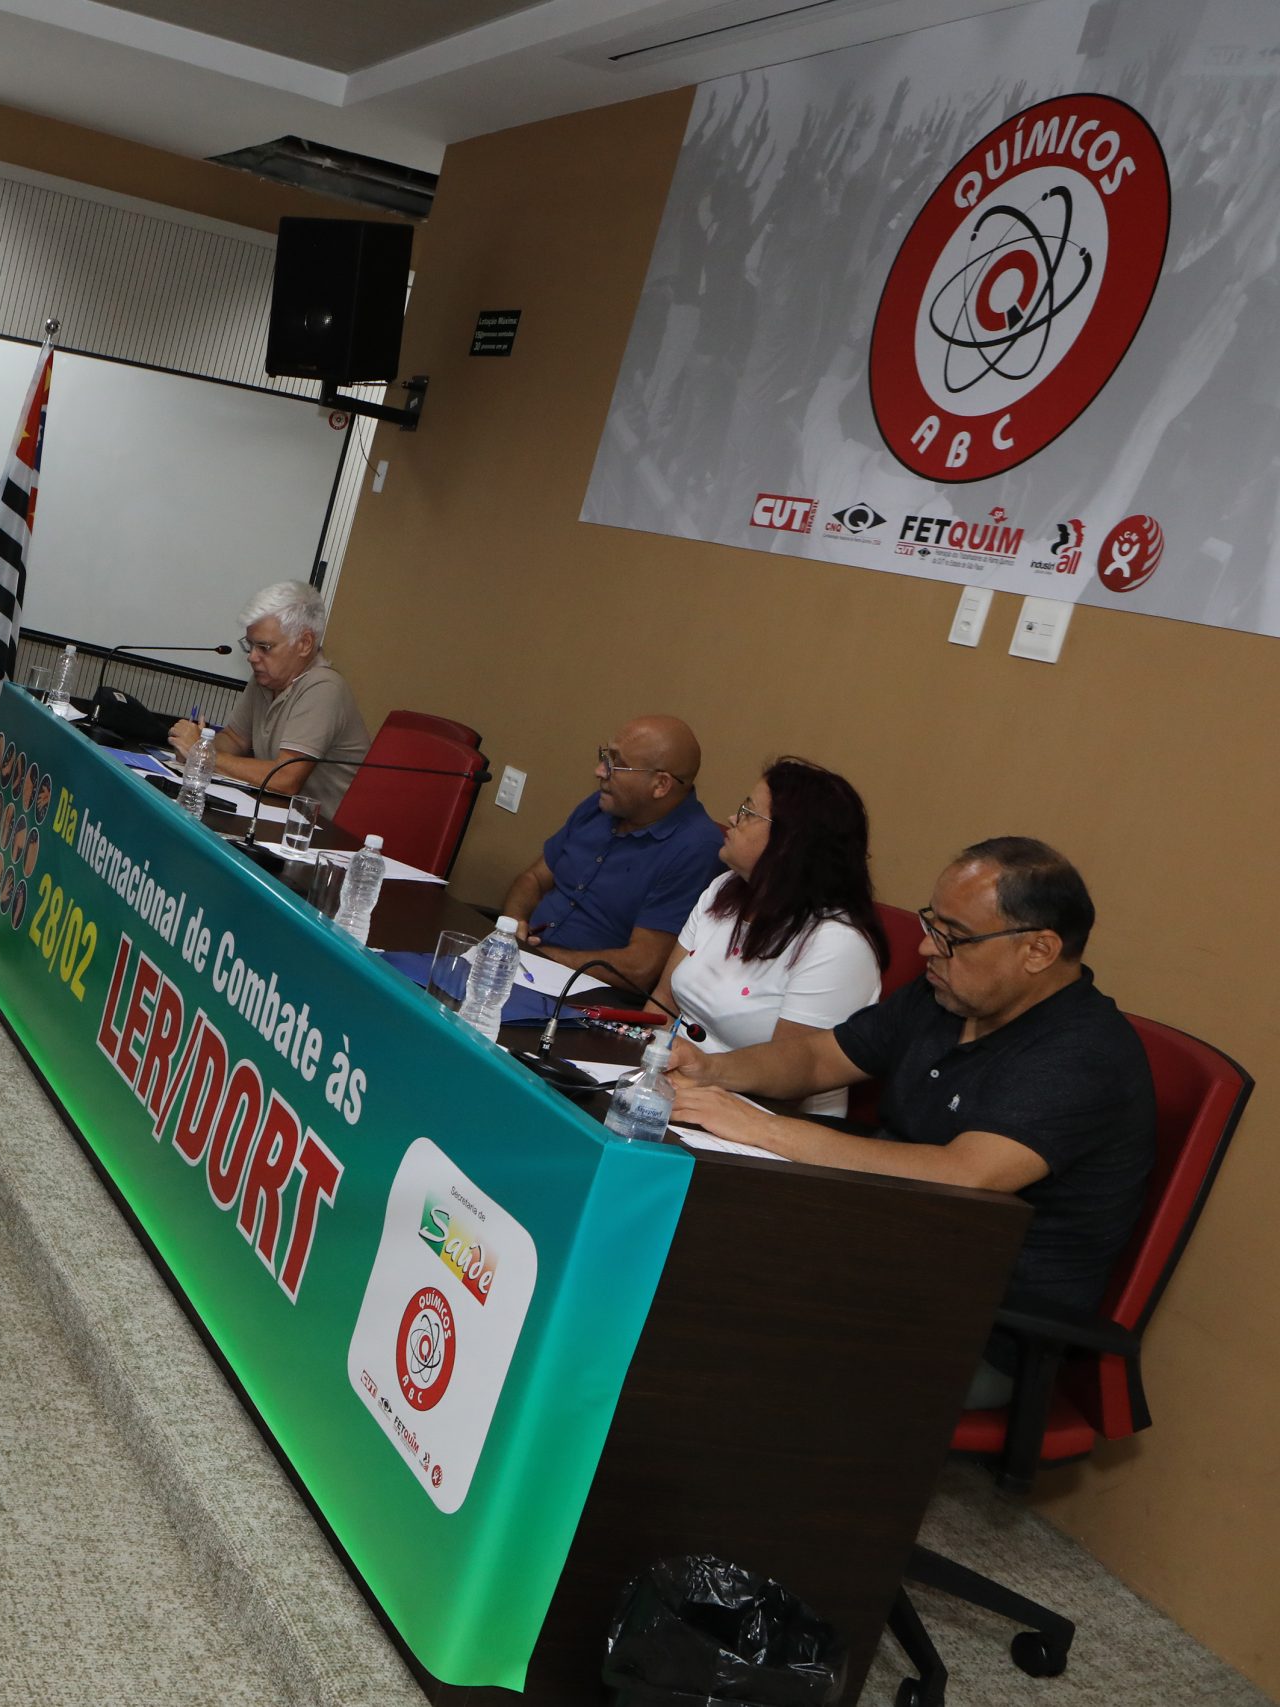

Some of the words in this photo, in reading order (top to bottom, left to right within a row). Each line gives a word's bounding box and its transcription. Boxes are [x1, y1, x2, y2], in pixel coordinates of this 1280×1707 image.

[953, 115, 1136, 208] QUÍMICOS
[753, 498, 812, 530] CUT
[825, 522, 841, 532] CNQ
[899, 515, 1025, 555] FETQUIM
[28, 873, 98, 1002] 28/02
[52, 787, 79, 846] Dia
[77, 808, 187, 944] Internacional
[181, 907, 211, 973] de
[212, 931, 323, 1082] Combate
[324, 1034, 367, 1124] às
[96, 932, 345, 1306] LER/DORT
[450, 1186, 478, 1218] Secretaria
[477, 1211, 486, 1223] de
[418, 1206, 494, 1295] Saúde
[419, 1290, 452, 1340] QUÍMICOS
[394, 1416, 420, 1454] FETQUIM
